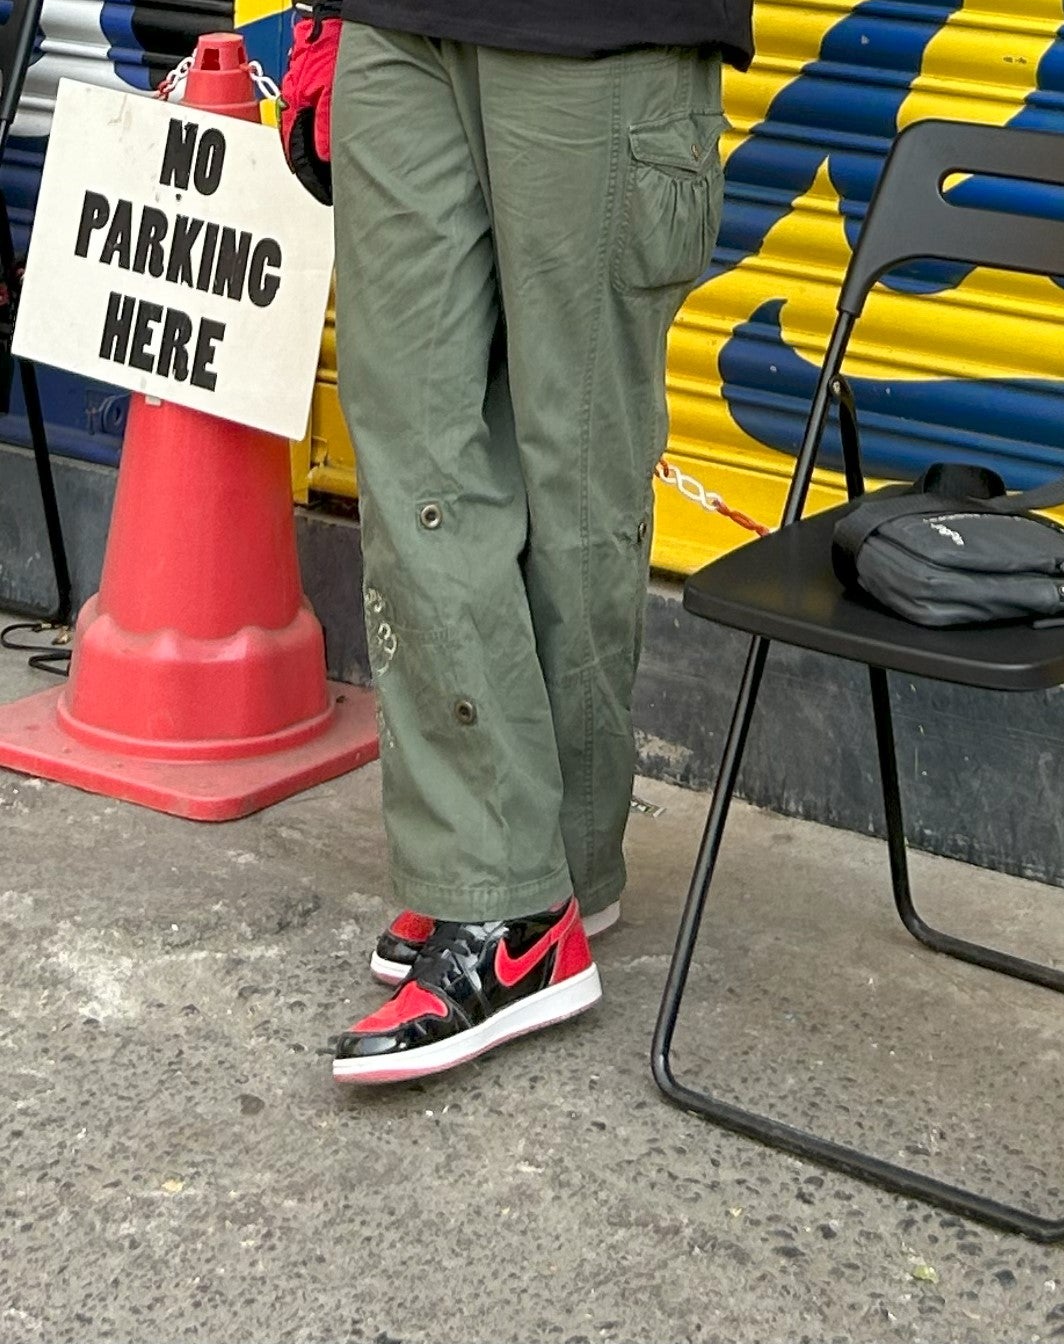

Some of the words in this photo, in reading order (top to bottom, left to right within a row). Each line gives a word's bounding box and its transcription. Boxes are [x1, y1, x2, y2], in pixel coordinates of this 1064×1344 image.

[159, 118, 226, 196] NO
[75, 190, 281, 308] PARKING
[99, 291, 226, 392] HERE
